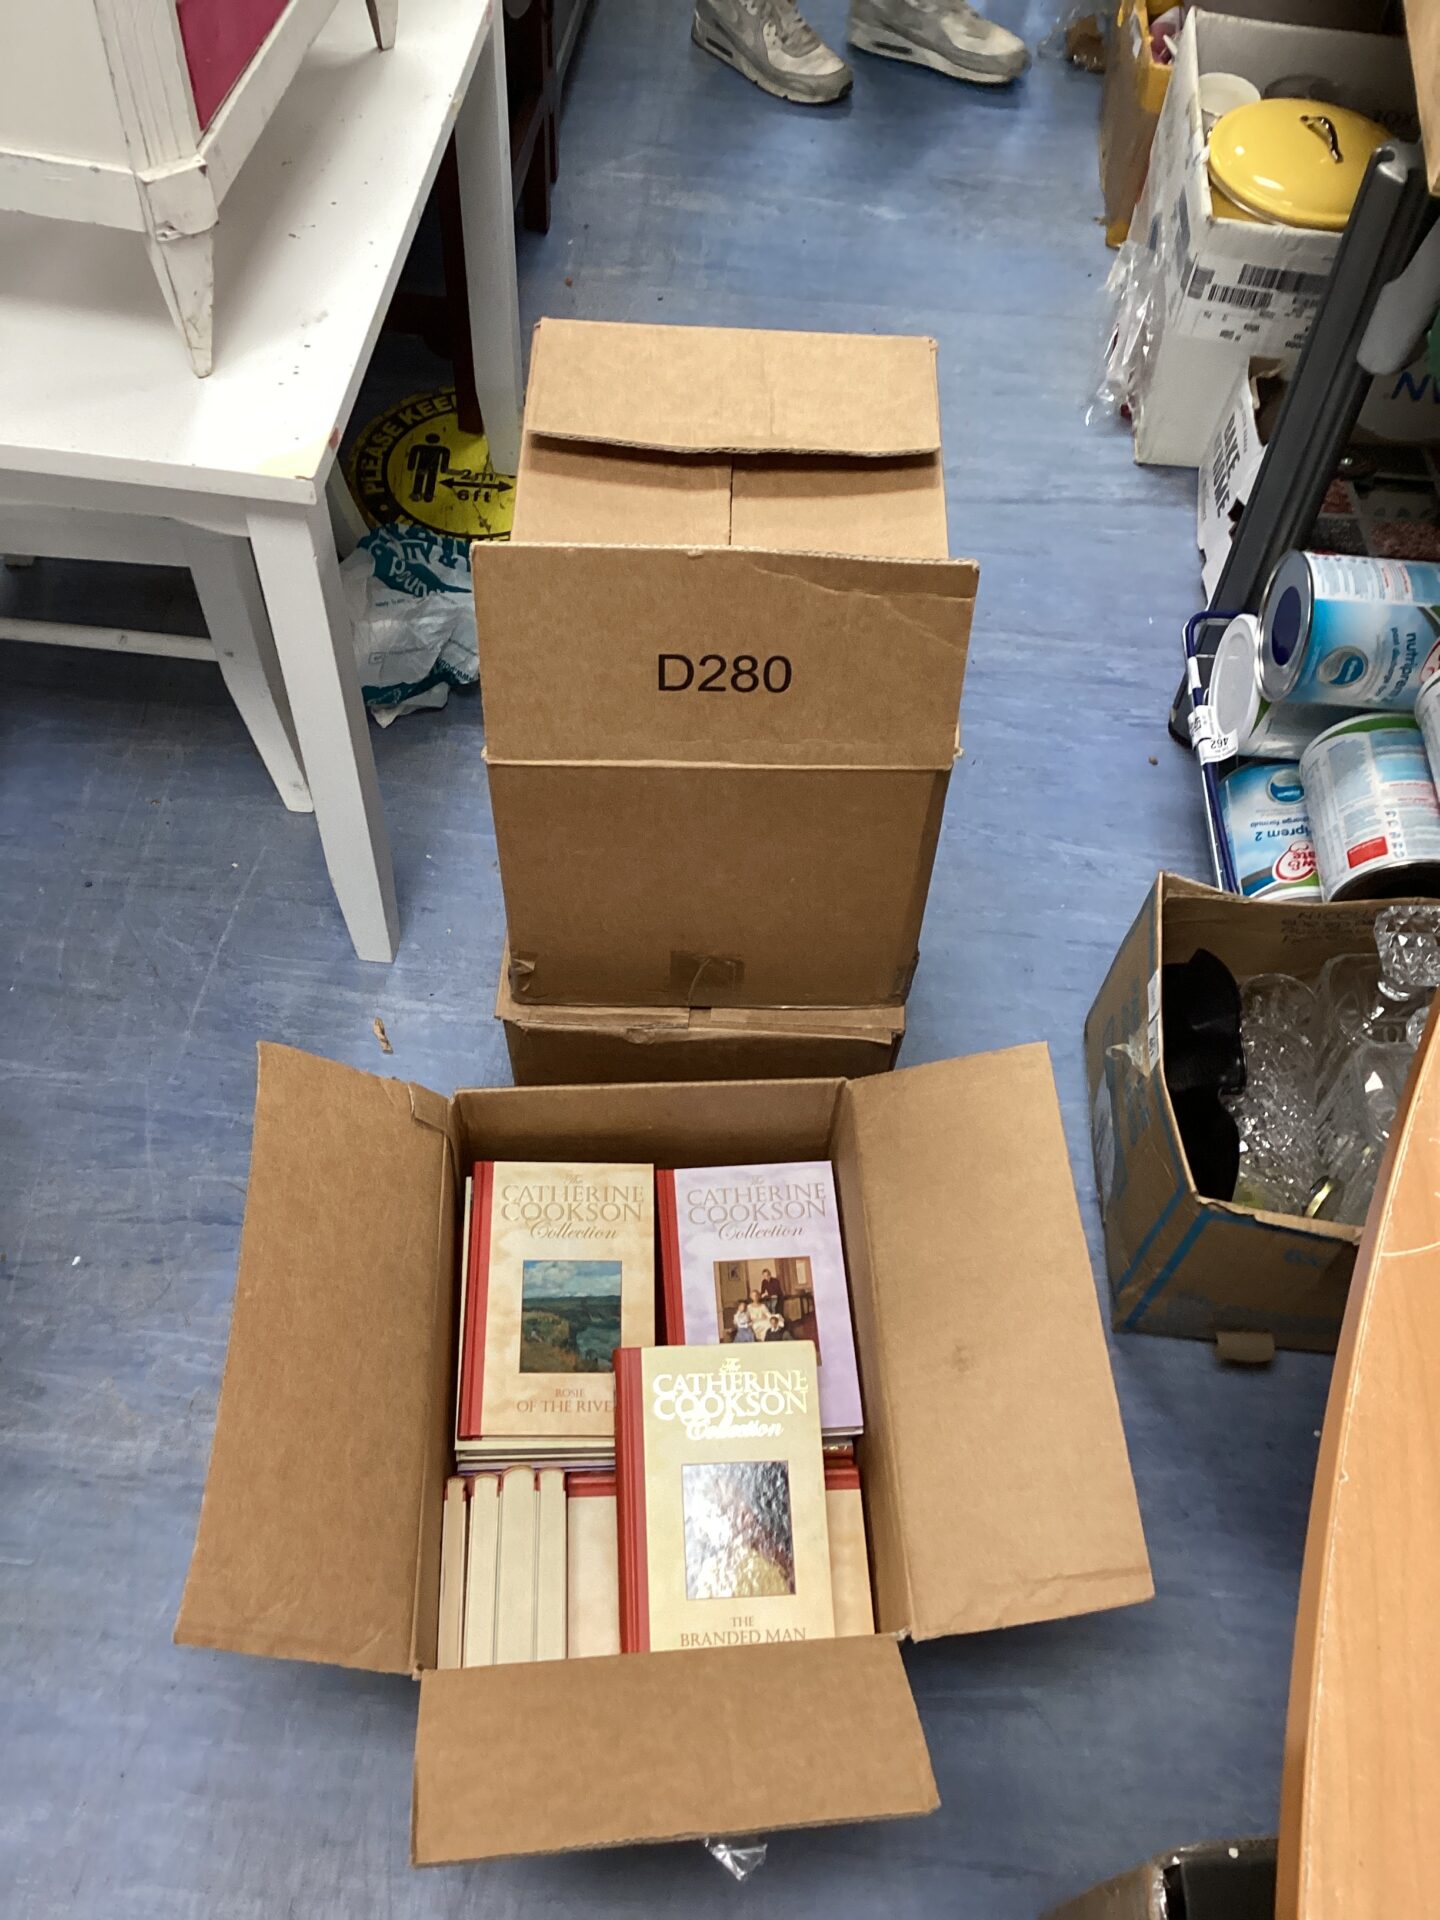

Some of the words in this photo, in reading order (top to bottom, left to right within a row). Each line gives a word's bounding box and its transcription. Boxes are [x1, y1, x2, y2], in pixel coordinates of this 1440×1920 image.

[362, 421, 403, 496] PLEASE
[402, 395, 457, 425] KEE
[460, 468, 494, 482] 2m
[456, 489, 492, 503] 6ft
[658, 653, 793, 694] D280
[501, 1184, 645, 1203] CATHERINE
[687, 1182, 827, 1207] CATHERINE
[501, 1202, 643, 1222] COOKSON
[687, 1200, 827, 1225] COOKSON
[526, 1219, 618, 1241] Collection
[714, 1219, 804, 1241] Collection
[554, 1388, 585, 1398] ROSIE
[652, 1369, 810, 1397] CATHERINE
[516, 1400, 537, 1413] OF
[541, 1400, 572, 1413] THE
[653, 1390, 809, 1421] COOKSON
[681, 1413, 785, 1441] Collection
[729, 1615, 755, 1628] THE
[679, 1629, 761, 1648] BRANDED
[766, 1627, 807, 1643] MAN
